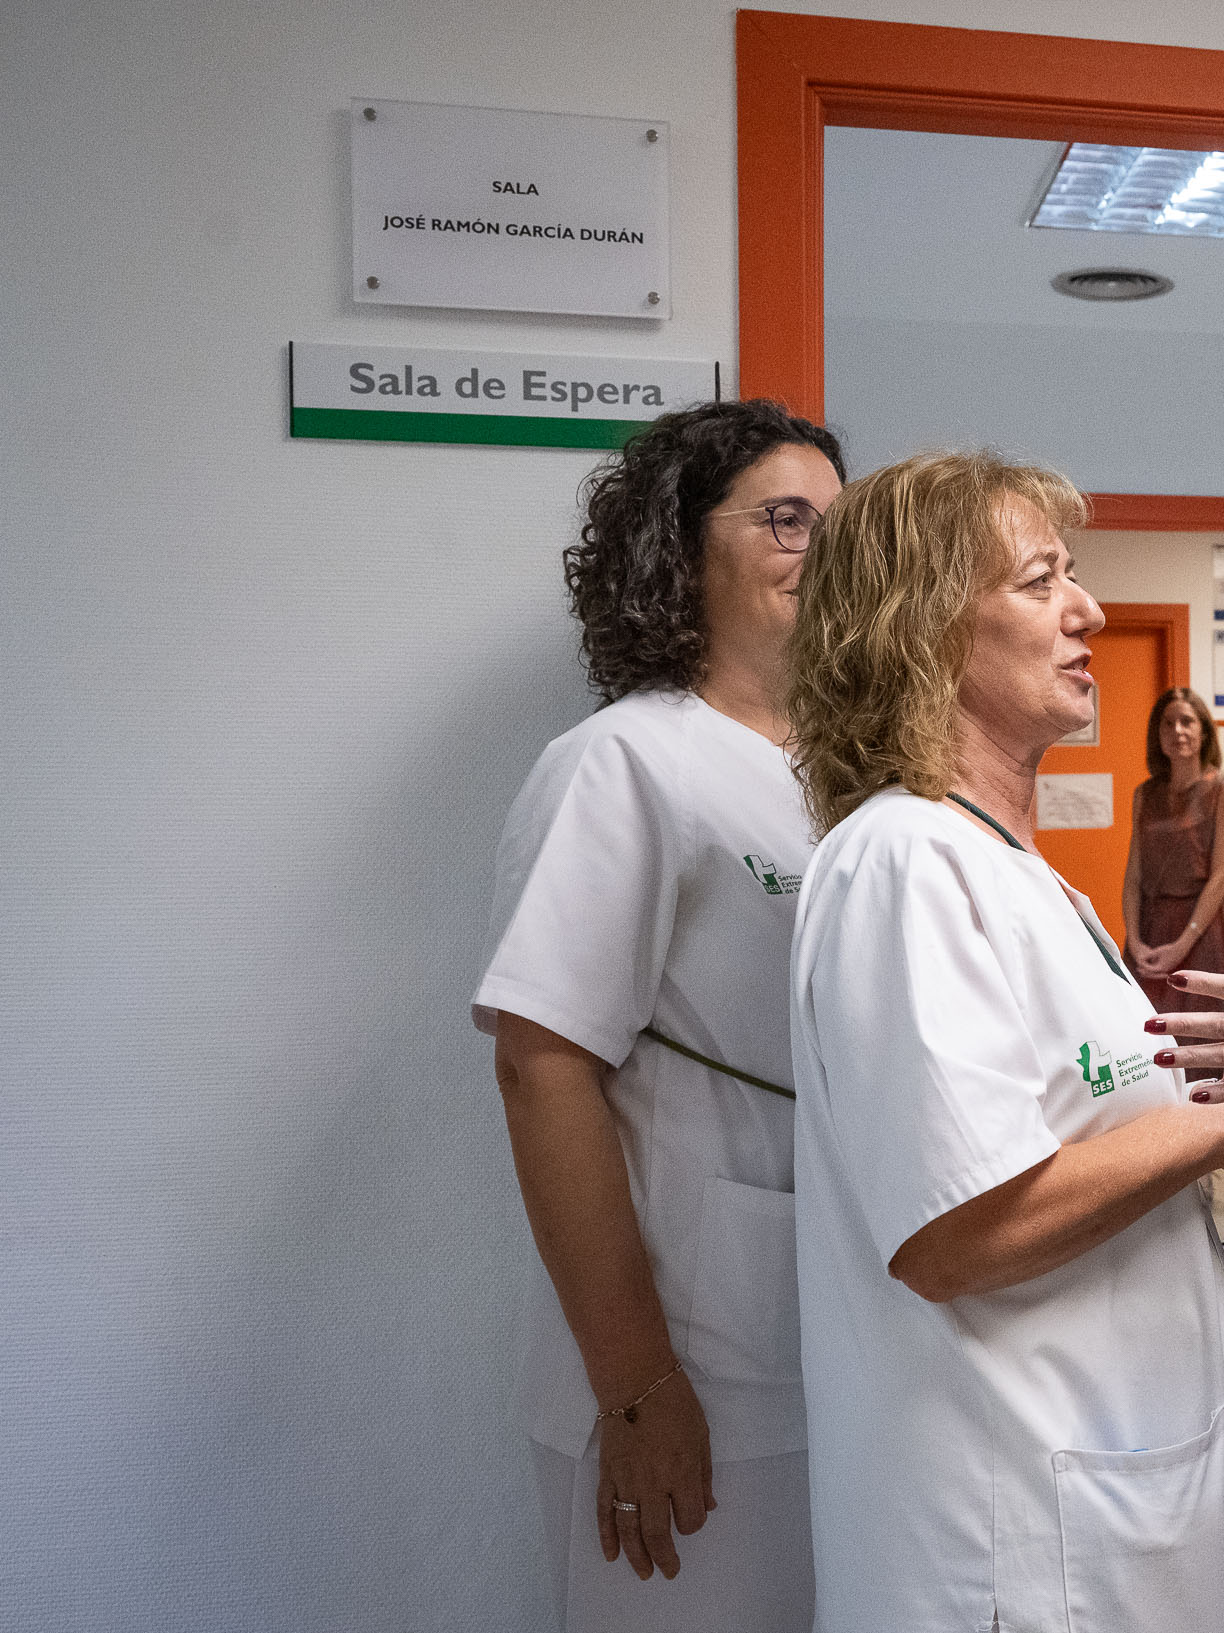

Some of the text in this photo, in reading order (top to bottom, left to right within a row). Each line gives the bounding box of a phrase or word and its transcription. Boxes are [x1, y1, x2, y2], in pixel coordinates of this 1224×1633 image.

[492, 180, 540, 197] SALA
[382, 214, 645, 244] JOSÉ RAMÓN GARCÍA DURÁN
[348, 361, 665, 413] Sala de Espera
[1116, 1052, 1143, 1068] Servicio
[1118, 1058, 1154, 1077] Extremeño
[1092, 1079, 1113, 1095] SES
[1121, 1069, 1149, 1087] de Salud
